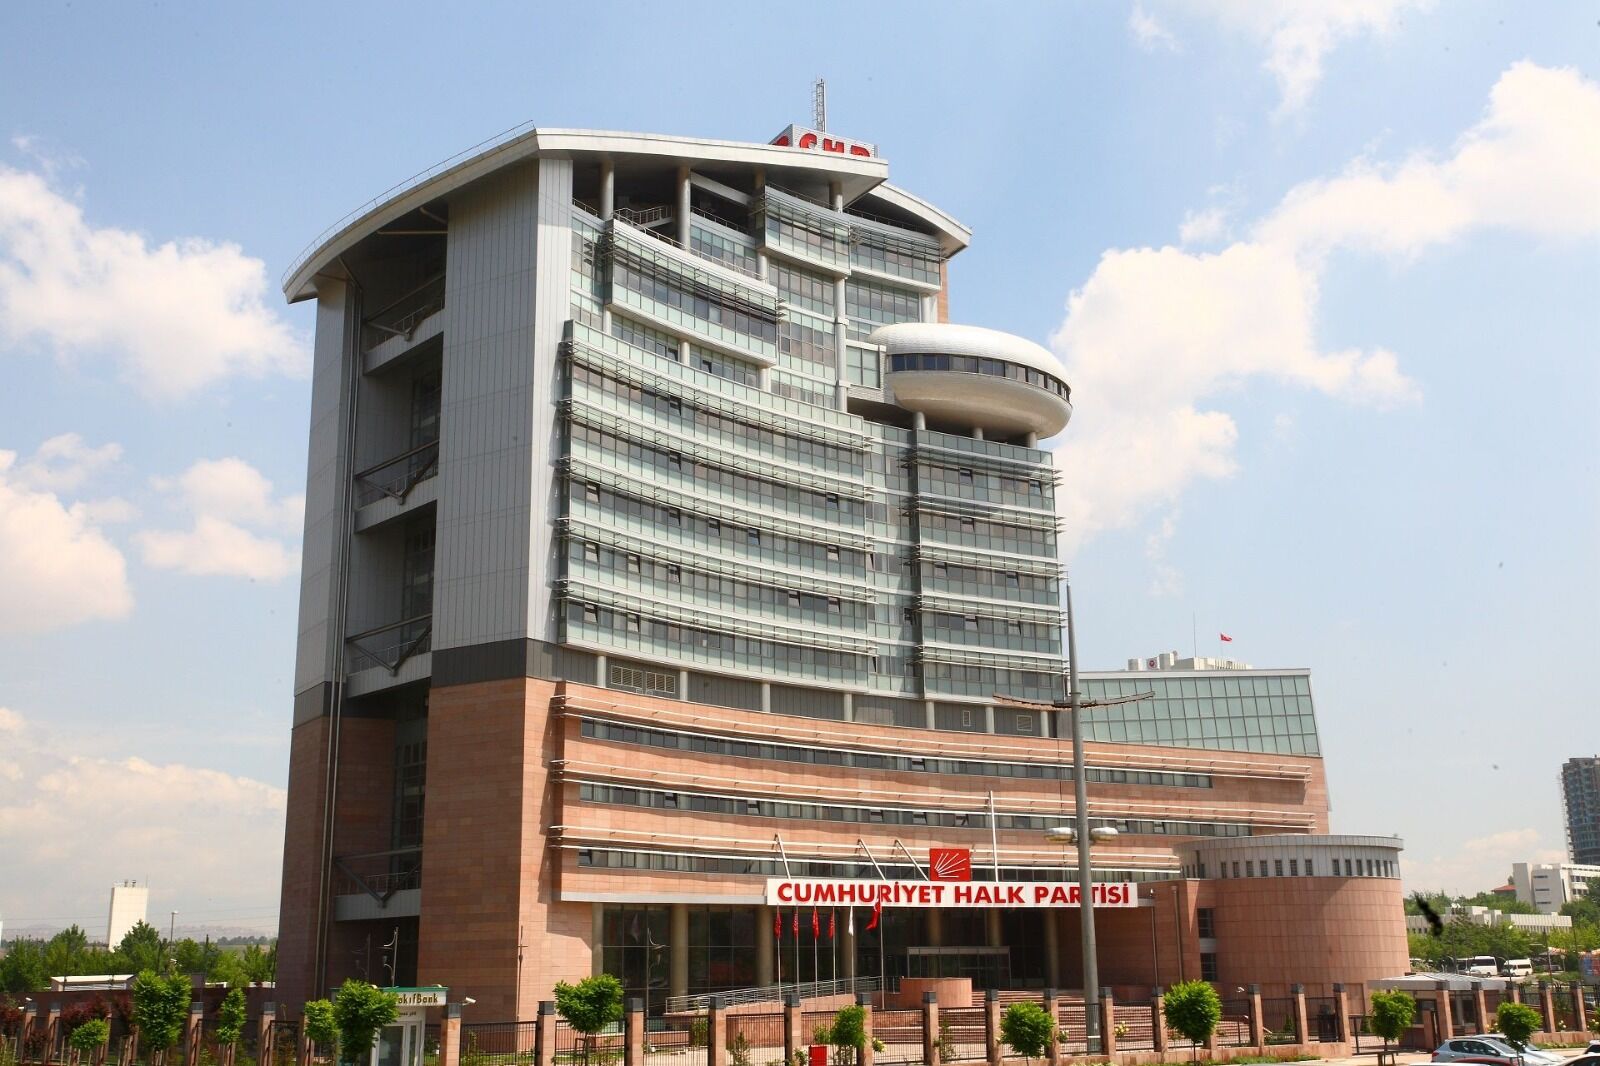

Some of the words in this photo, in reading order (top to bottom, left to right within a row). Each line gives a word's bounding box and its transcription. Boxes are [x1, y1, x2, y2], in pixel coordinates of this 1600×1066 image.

[777, 881, 945, 904] CUMHURİYET
[954, 885, 1026, 904] HALK
[1034, 883, 1129, 904] PARTİSİ
[397, 992, 438, 1005] akıfBank
